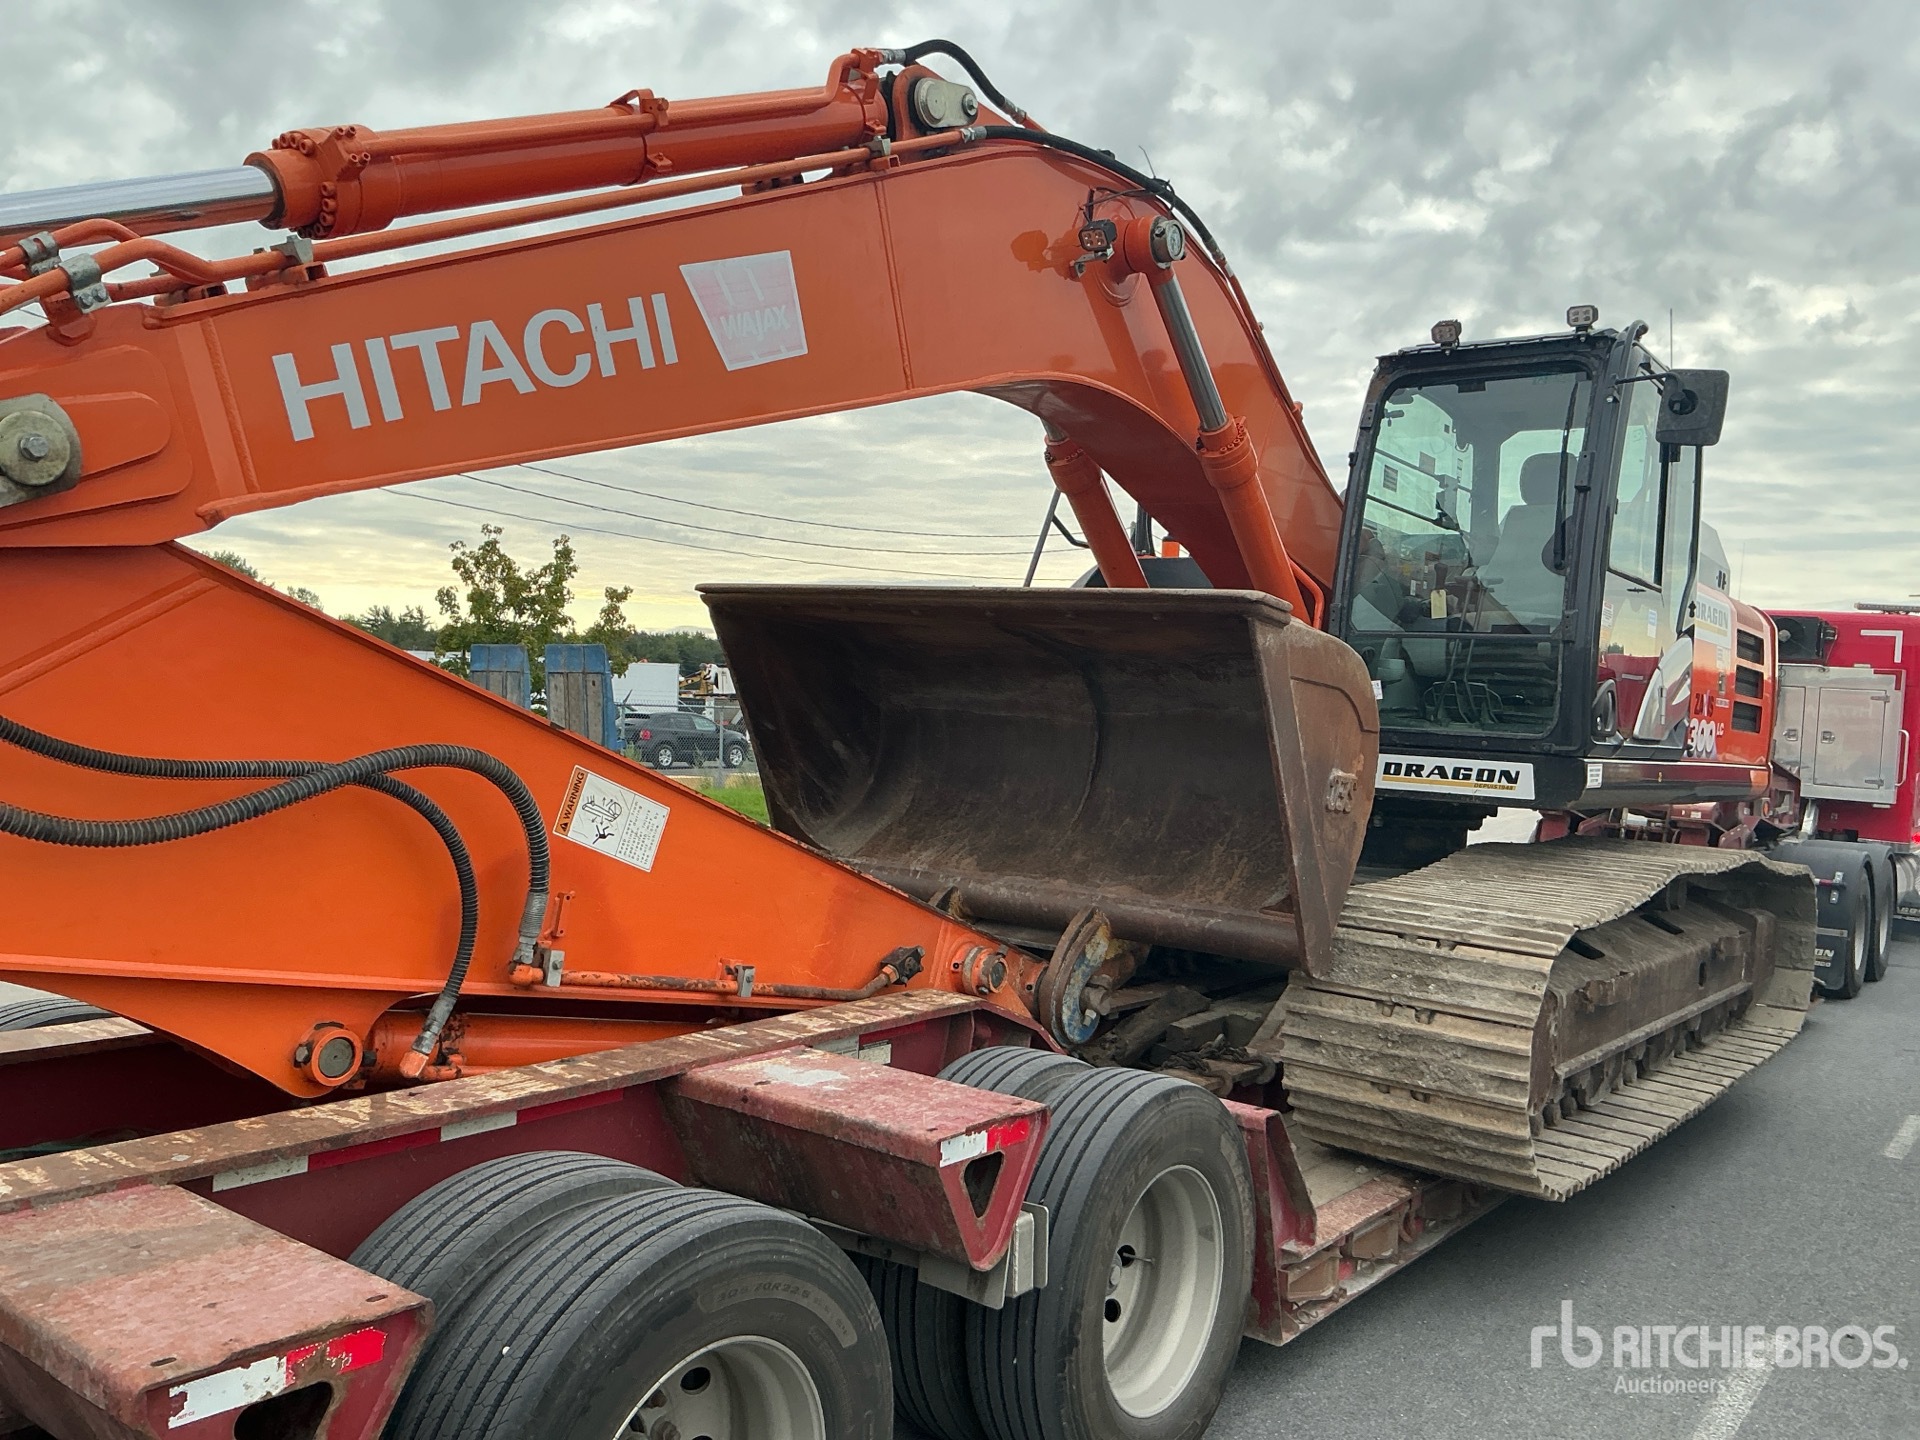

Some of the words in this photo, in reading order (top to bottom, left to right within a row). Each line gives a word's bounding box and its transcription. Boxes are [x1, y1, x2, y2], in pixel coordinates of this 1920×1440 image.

[720, 305, 791, 342] WAJAX
[272, 293, 679, 441] HITACHI
[1696, 601, 1728, 630] DRAGON
[1688, 717, 1715, 753] 300
[1383, 762, 1520, 785] DRAGON
[563, 772, 585, 820] WARNING
